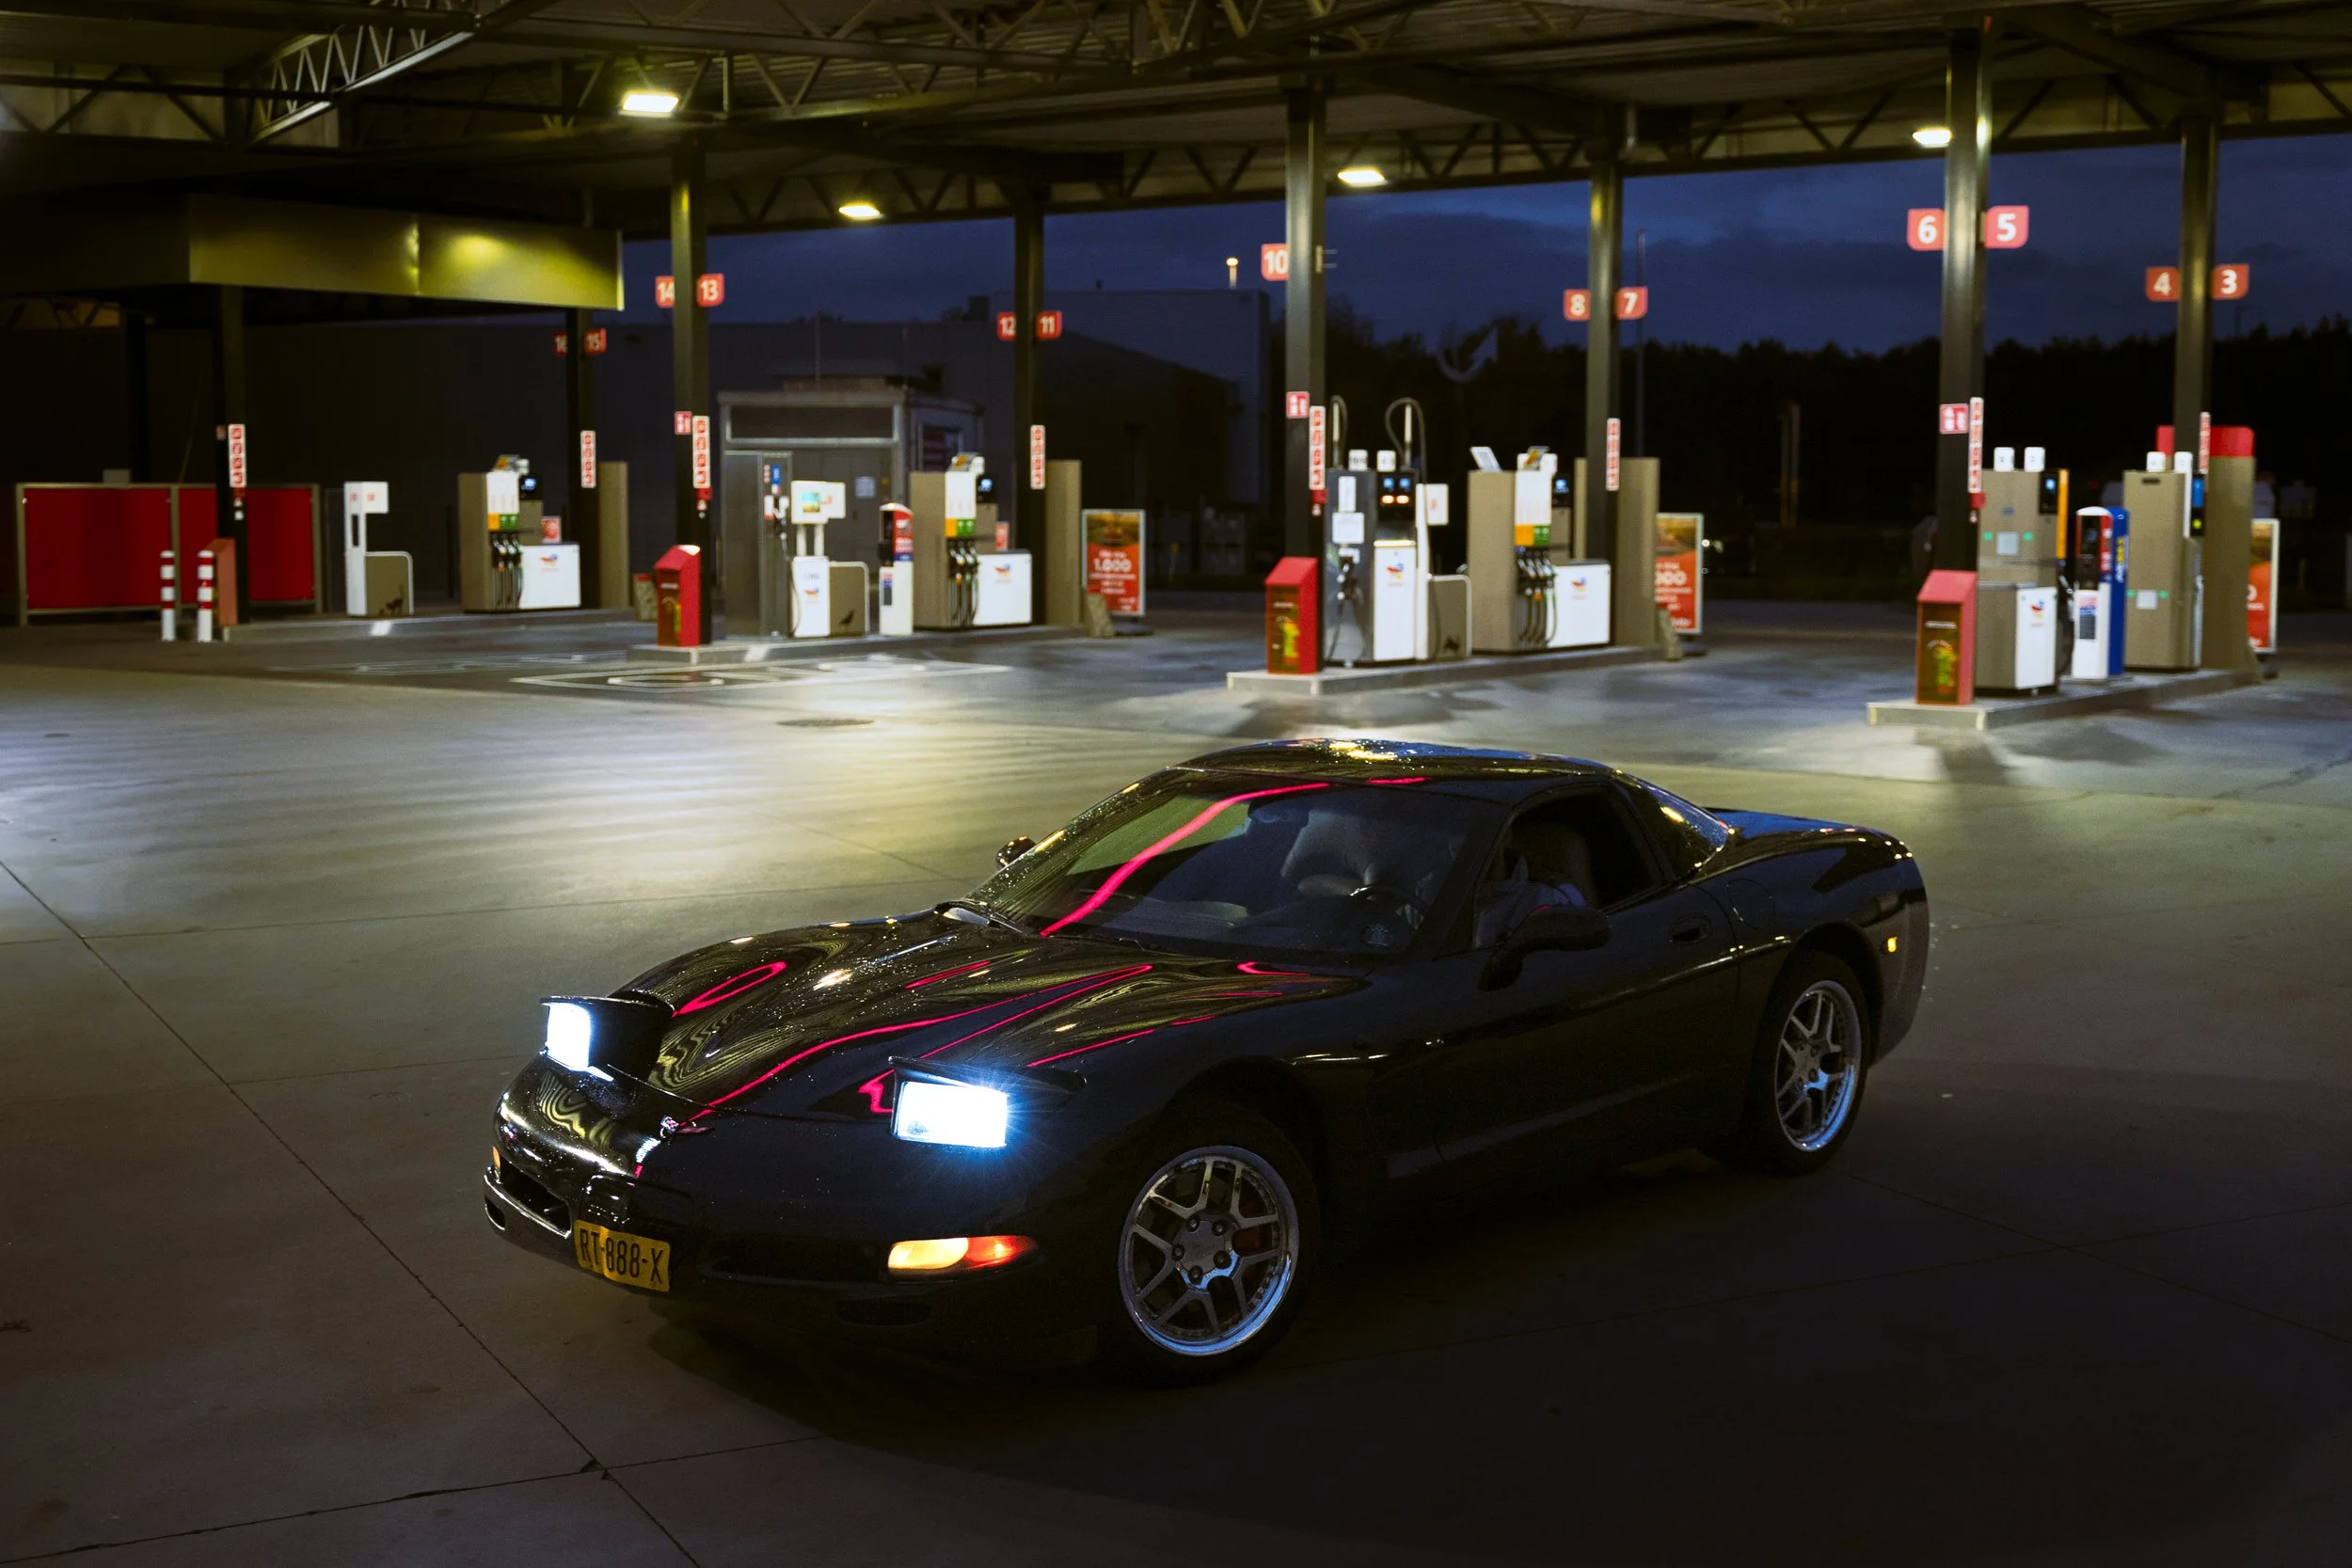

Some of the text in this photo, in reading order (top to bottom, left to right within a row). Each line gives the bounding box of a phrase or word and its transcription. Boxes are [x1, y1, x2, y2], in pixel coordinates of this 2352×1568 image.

[1917, 214, 1936, 245] 6
[1996, 213, 2017, 242] 5
[1264, 249, 1289, 275] 10
[658, 281, 675, 302] 14
[700, 279, 719, 302] 13
[2153, 271, 2171, 296] 4
[2220, 269, 2237, 294] 3
[1569, 293, 1586, 316] 8
[1623, 292, 1639, 314] 7
[999, 316, 1016, 336] 12
[1039, 316, 1055, 334] 11
[580, 1227, 664, 1286] RT-888-X
